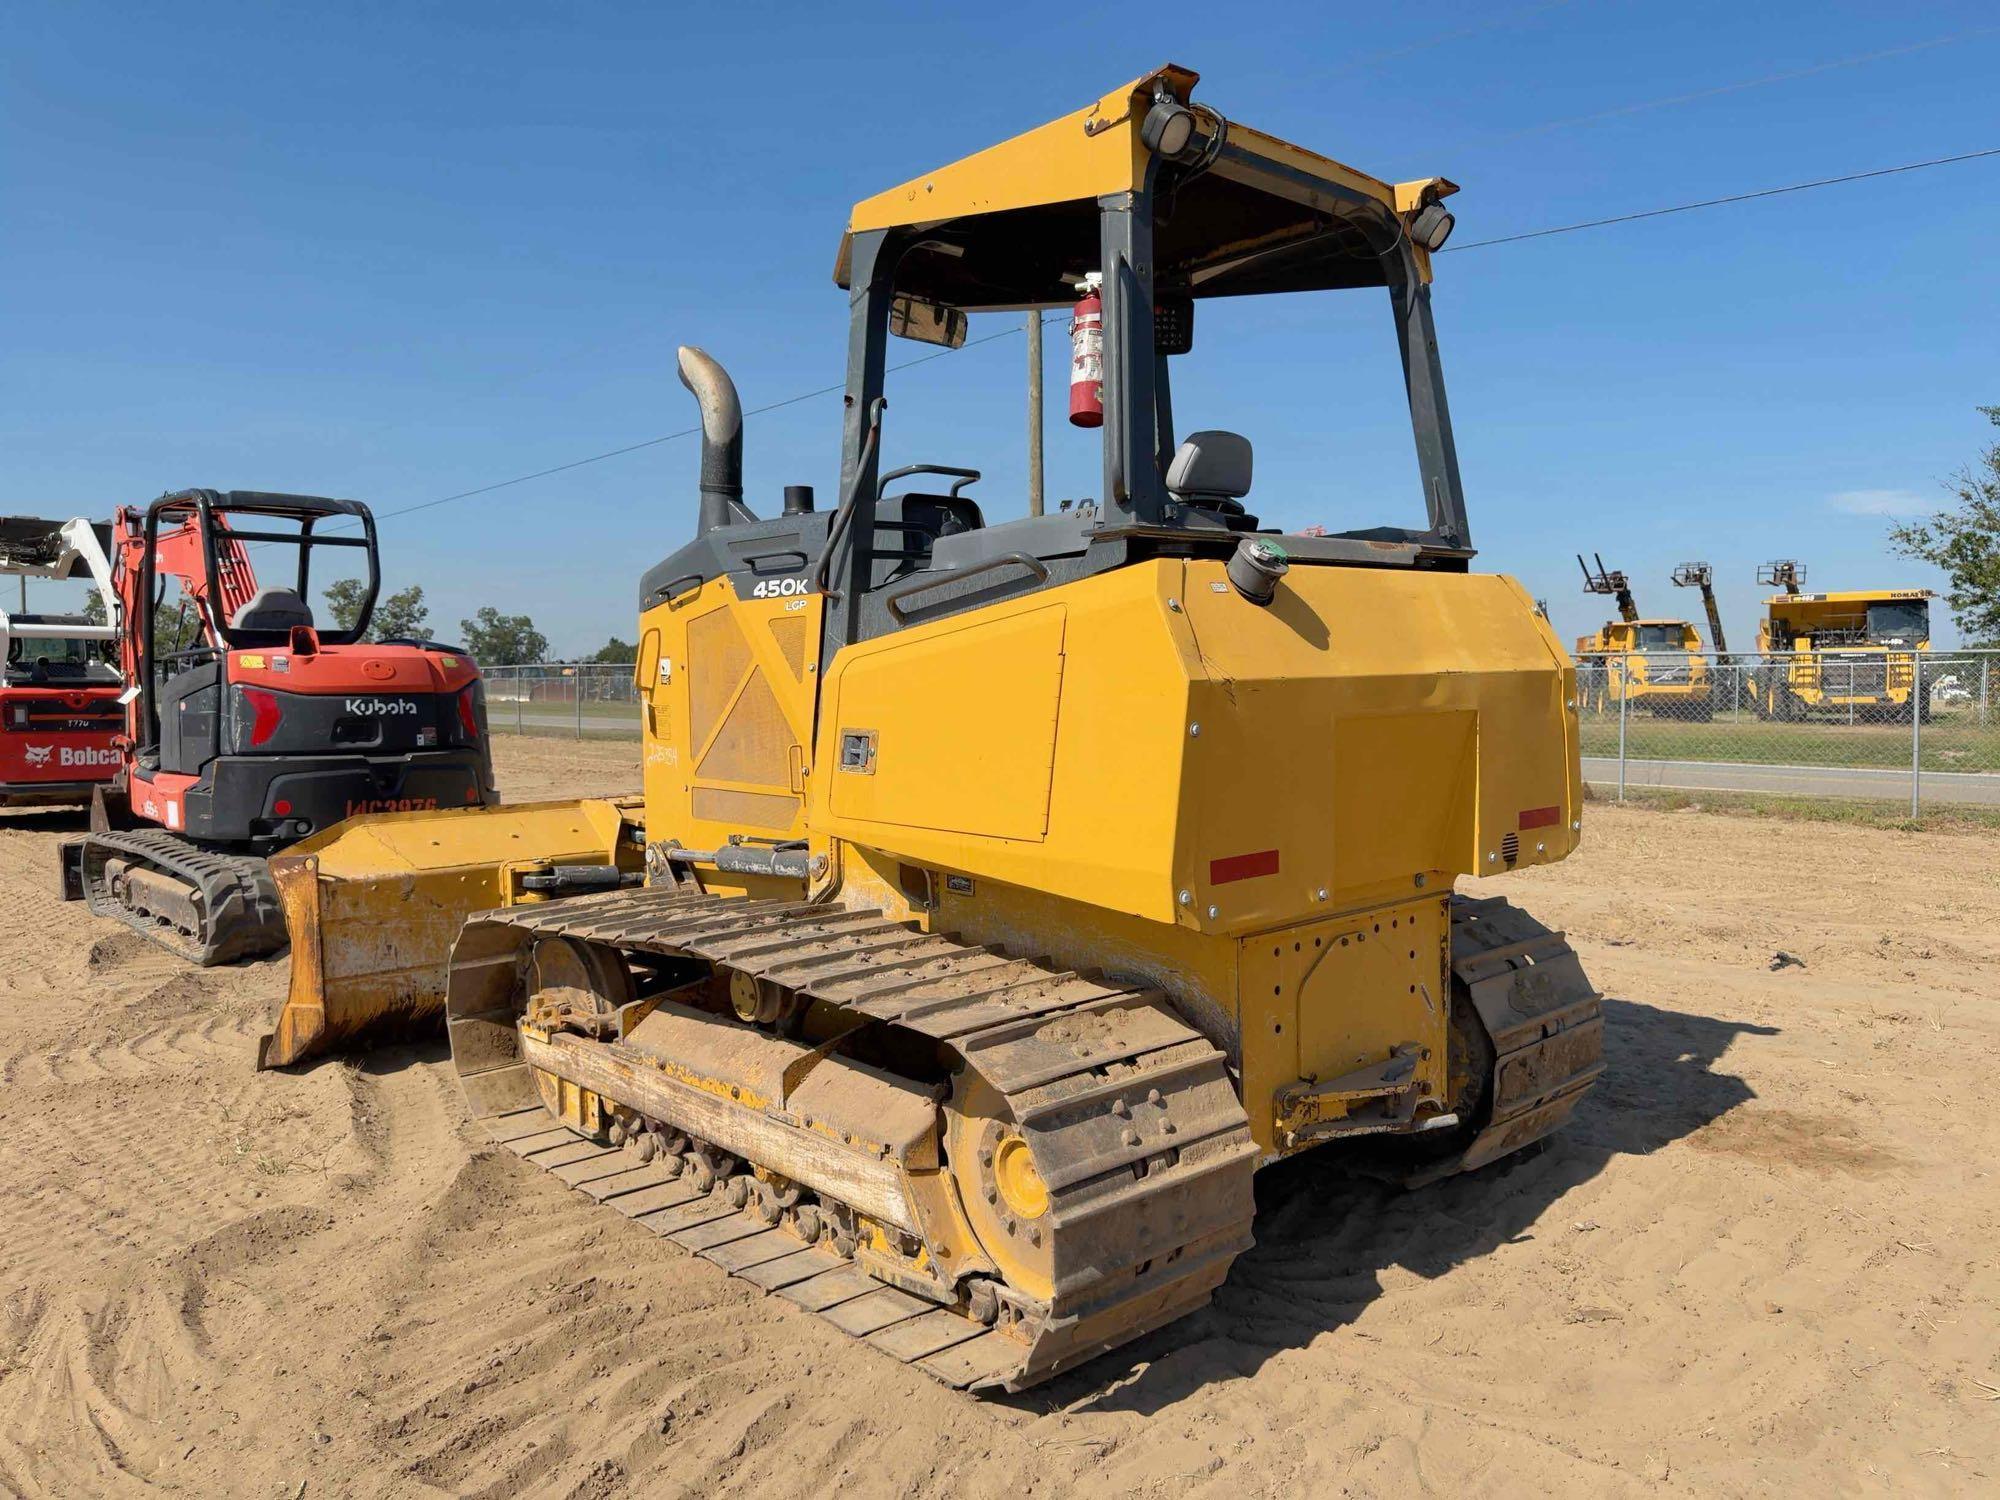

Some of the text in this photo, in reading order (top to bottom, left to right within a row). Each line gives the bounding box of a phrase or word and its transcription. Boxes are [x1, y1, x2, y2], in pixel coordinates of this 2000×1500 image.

[753, 578, 809, 599] 450K
[785, 600, 807, 611] LGP
[345, 698, 417, 715] Kubota
[60, 746, 121, 766] Bobca
